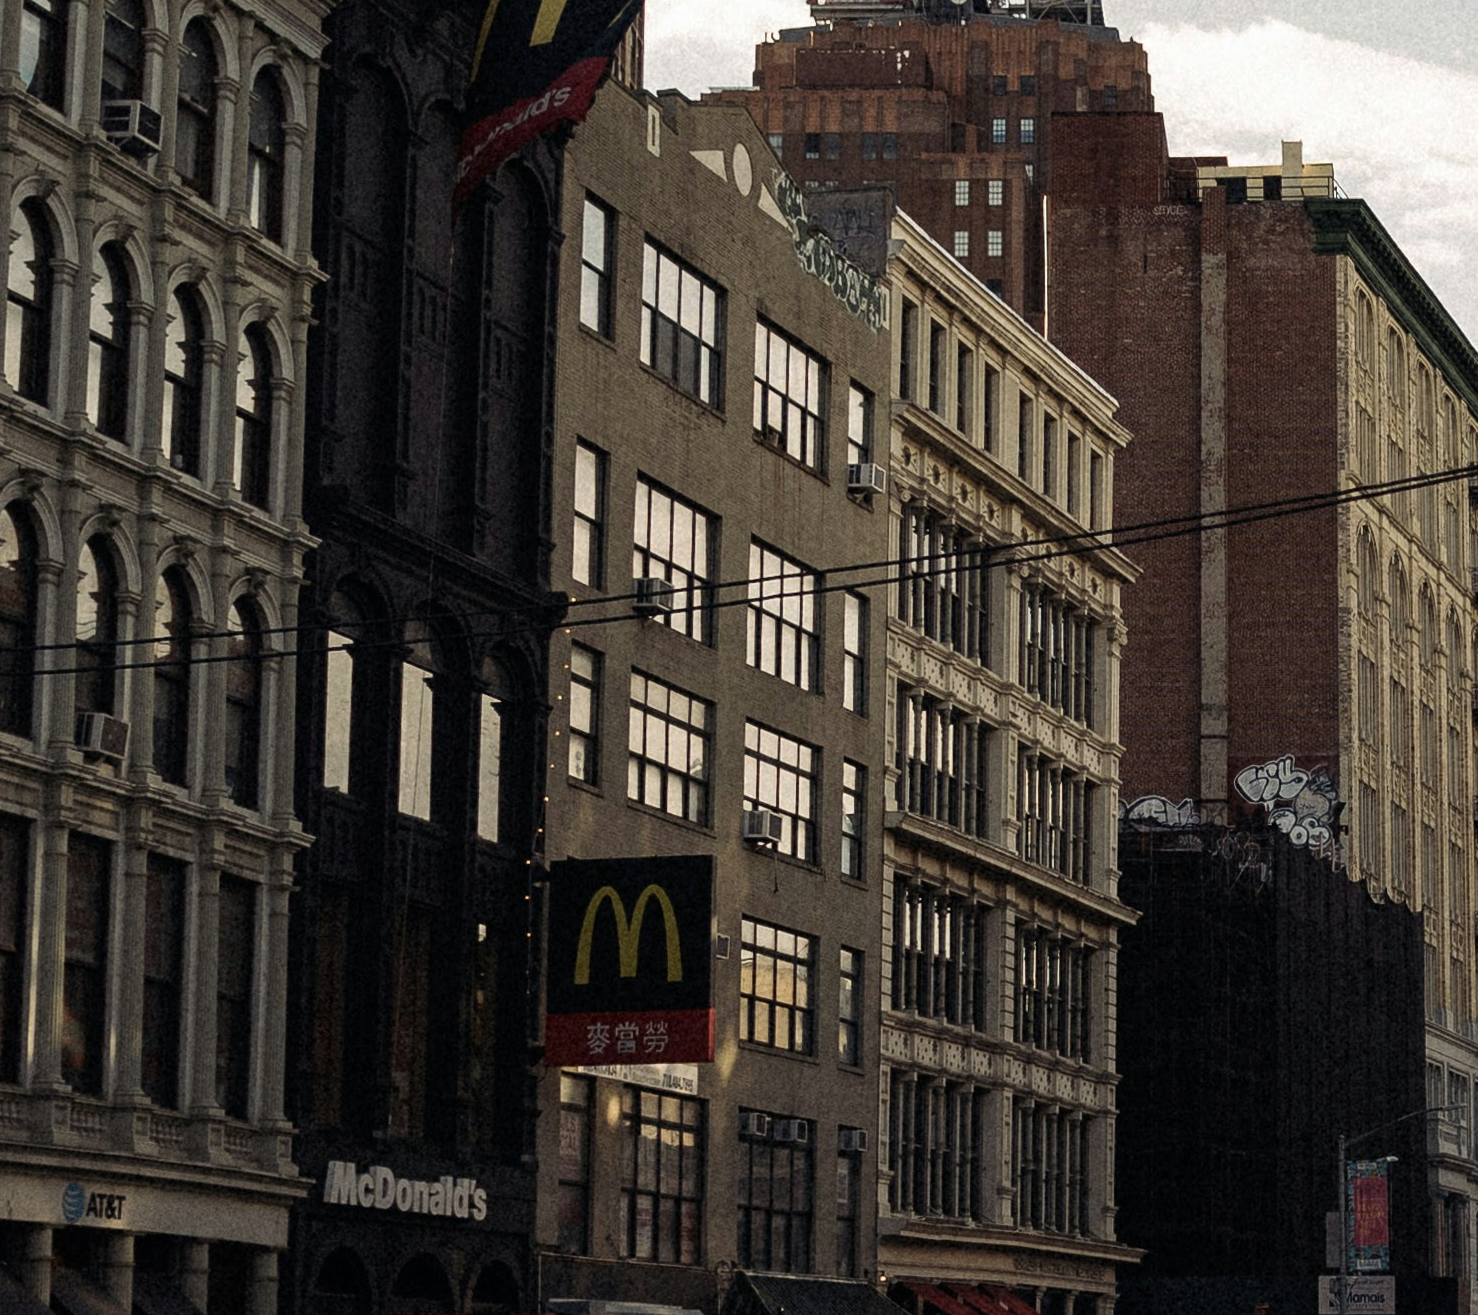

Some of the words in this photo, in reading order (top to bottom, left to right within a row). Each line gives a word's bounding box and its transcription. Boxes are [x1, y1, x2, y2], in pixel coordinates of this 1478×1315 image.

[586, 1021, 669, 1055] 麥當勞
[87, 1193, 125, 1219] AT&T
[323, 1160, 487, 1221] McDonald's
